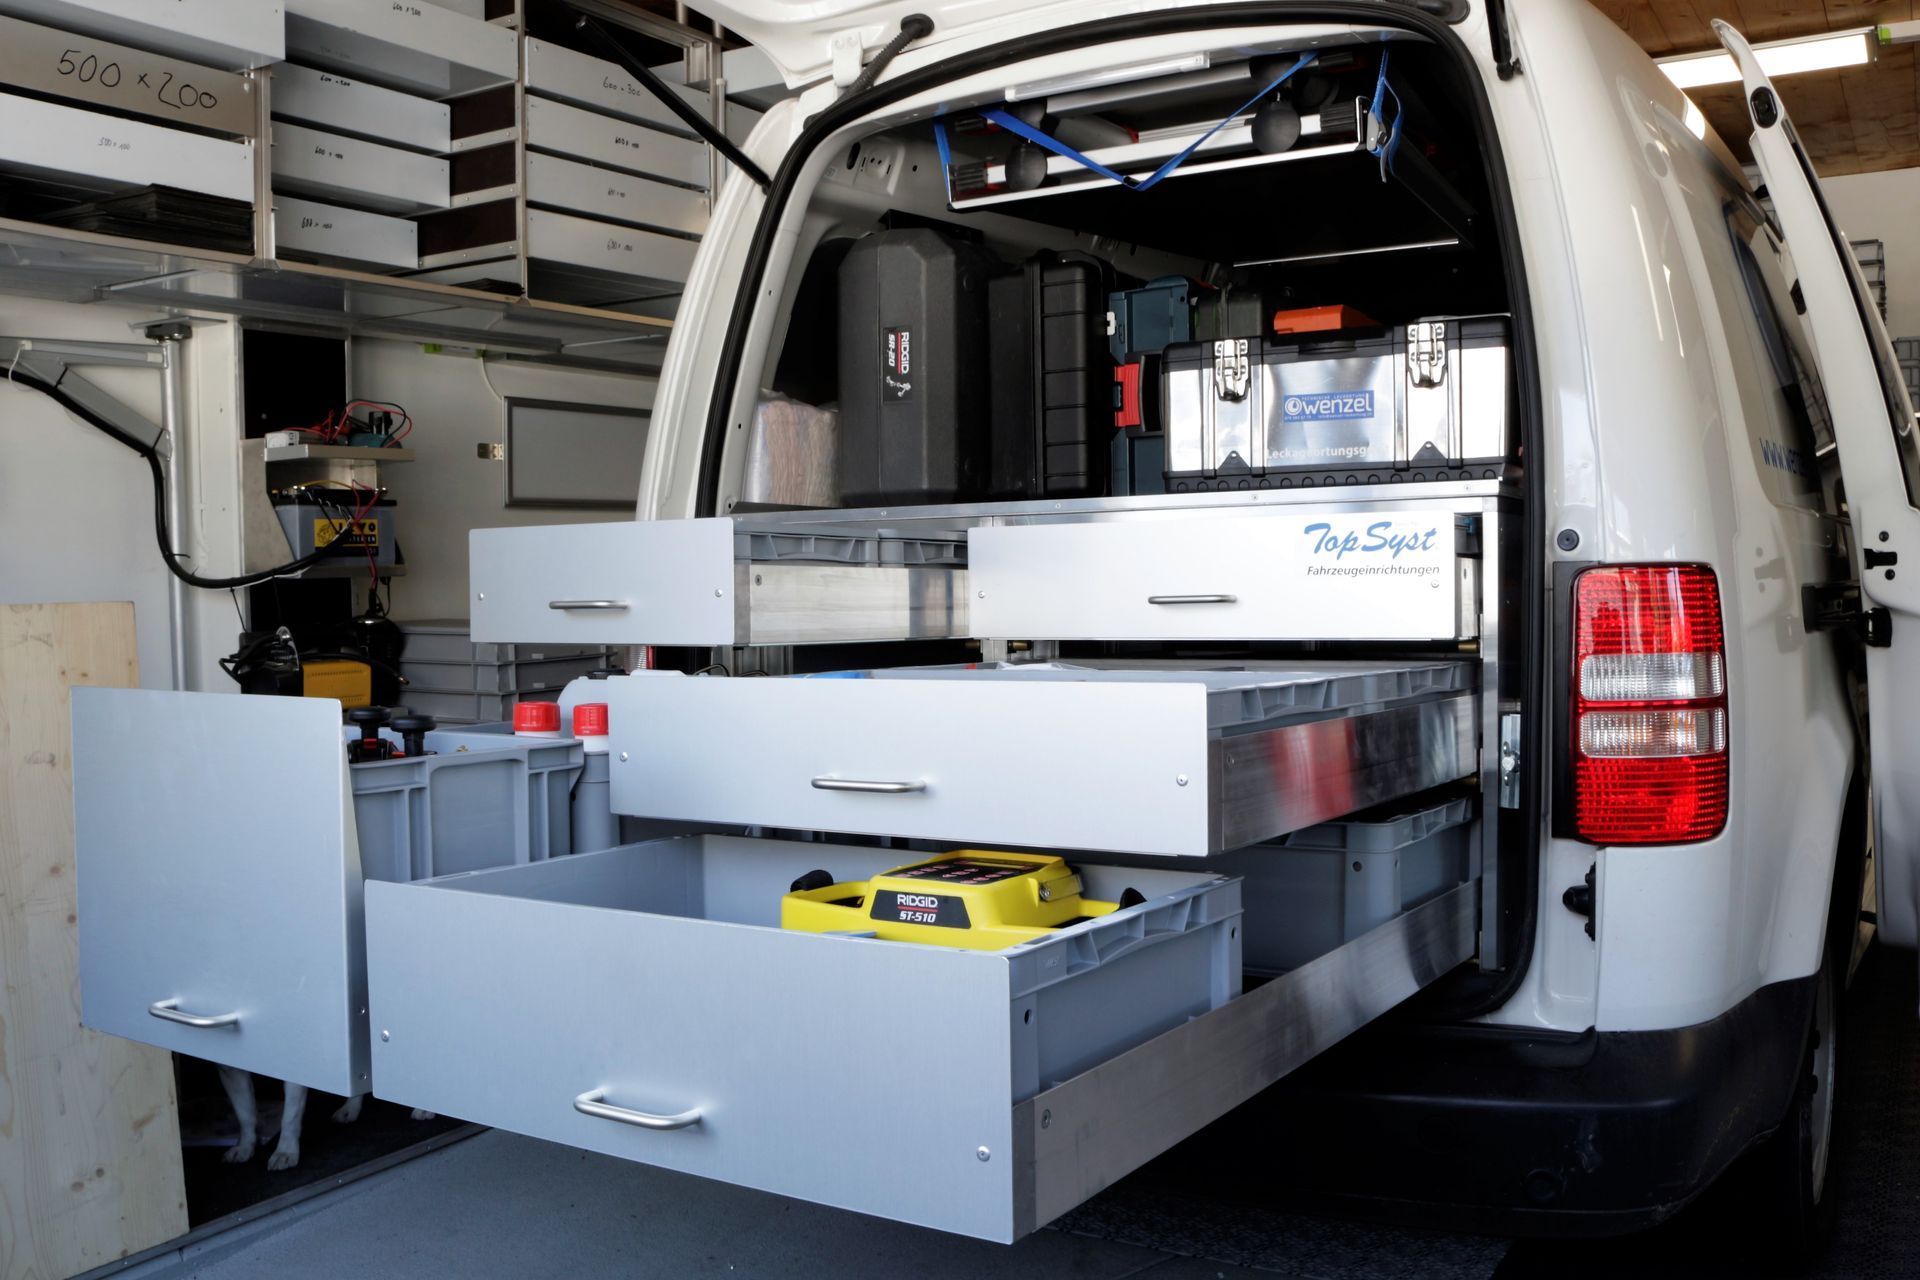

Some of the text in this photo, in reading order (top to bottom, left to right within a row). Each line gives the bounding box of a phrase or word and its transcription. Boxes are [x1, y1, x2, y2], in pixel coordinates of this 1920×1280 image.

[57, 49, 121, 87] 500
[158, 72, 217, 109] 200
[888, 333, 896, 367] SR-20
[901, 331, 910, 375] RIDGID
[1302, 392, 1372, 415] wenzel
[1307, 565, 1440, 578] Fahrzeugeinrichtungen
[897, 893, 938, 908] RIDGID
[899, 910, 937, 923] ST-510
